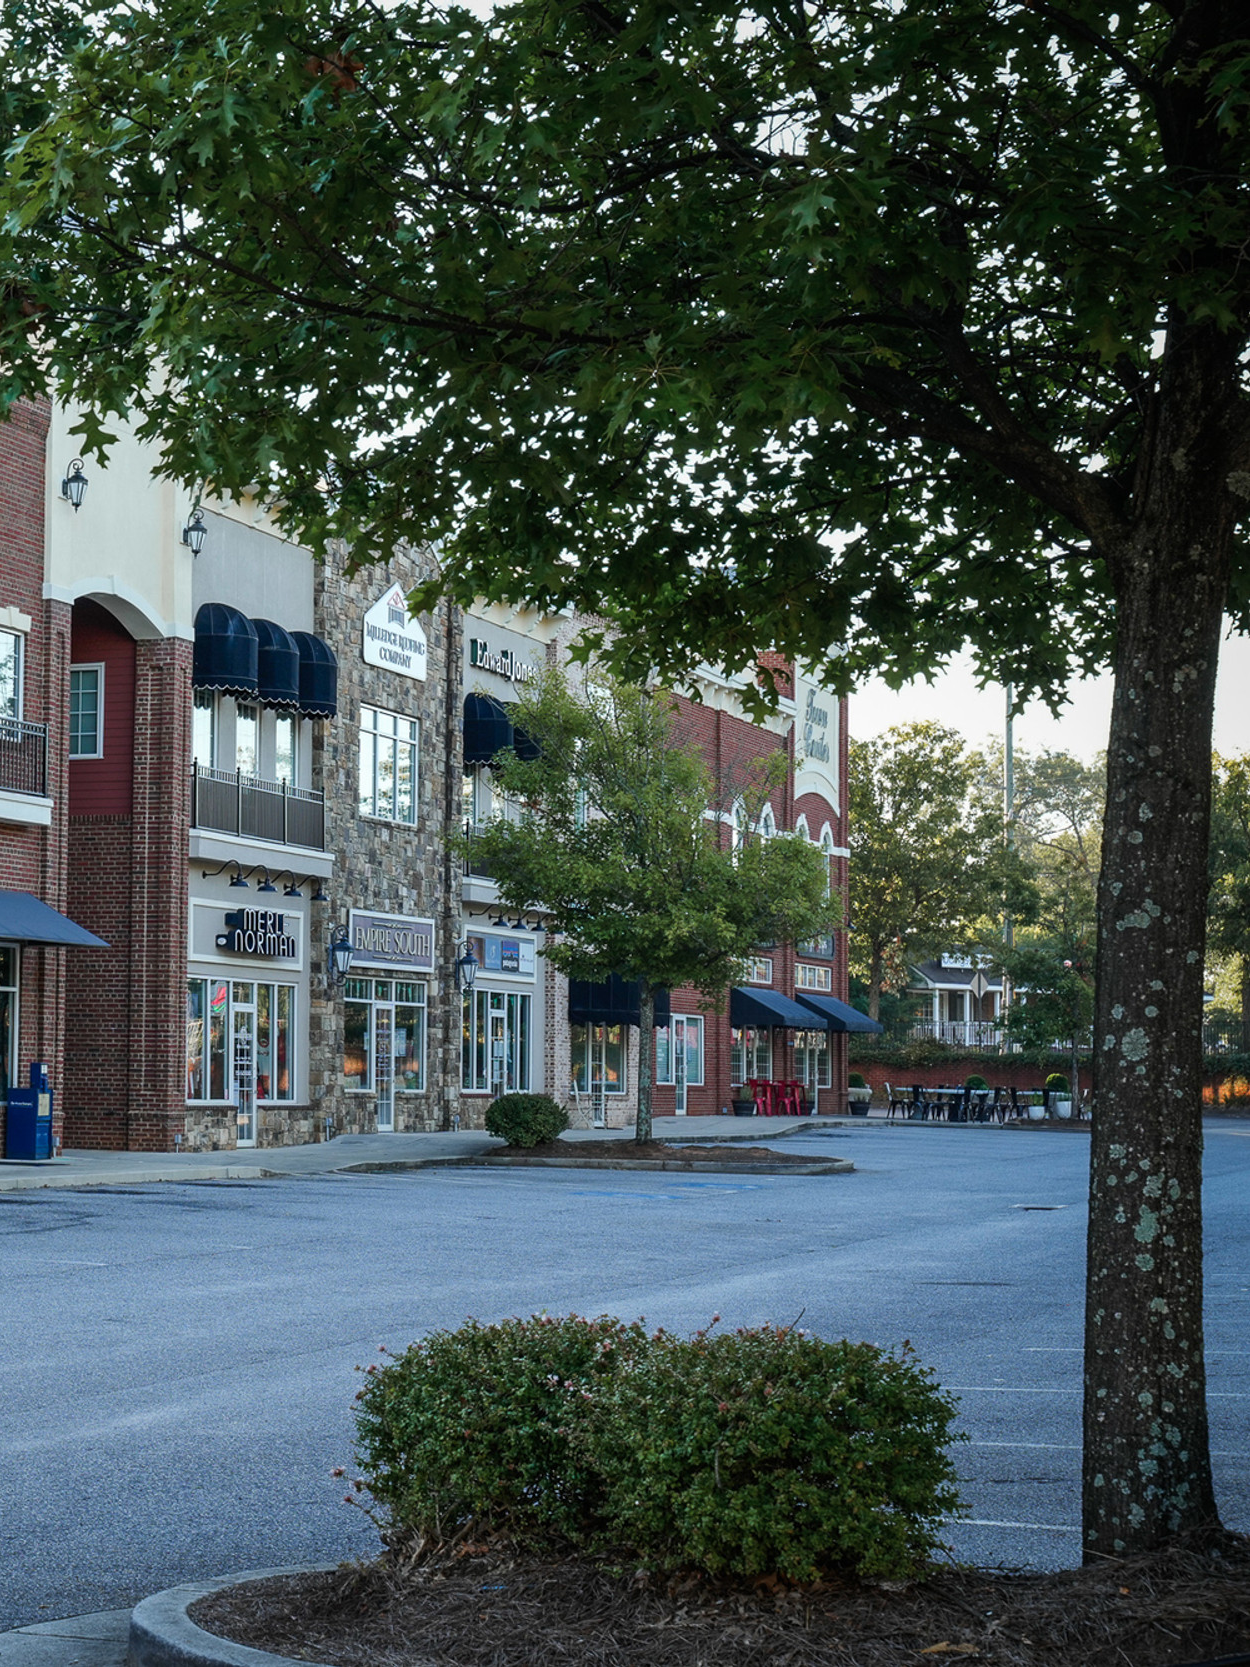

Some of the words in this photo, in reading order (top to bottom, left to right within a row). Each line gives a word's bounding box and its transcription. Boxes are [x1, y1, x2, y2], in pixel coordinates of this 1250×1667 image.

[235, 929, 297, 959] NORMAN
[355, 926, 392, 953] EMPIRE
[394, 930, 430, 957] SOUTH
